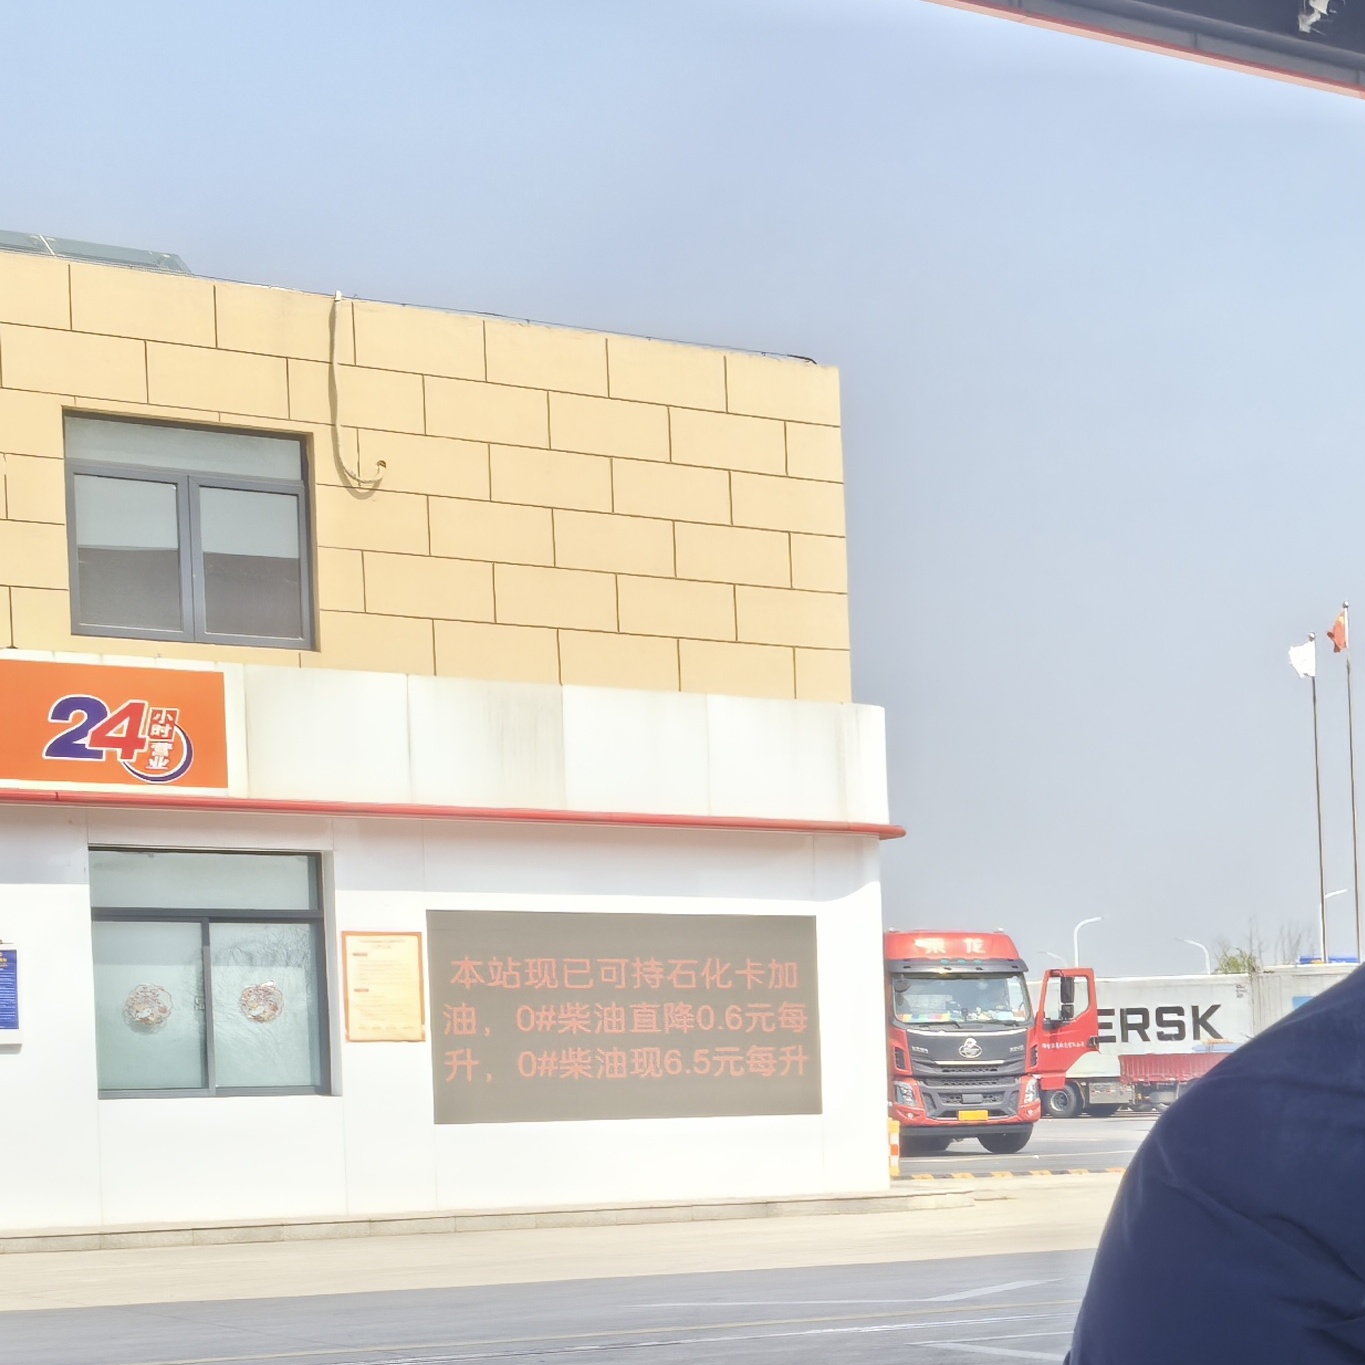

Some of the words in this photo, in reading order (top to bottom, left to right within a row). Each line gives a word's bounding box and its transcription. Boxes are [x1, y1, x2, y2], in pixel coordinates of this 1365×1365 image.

[42, 693, 149, 763] 24
[450, 955, 798, 990] 本站现已可持石化卡加
